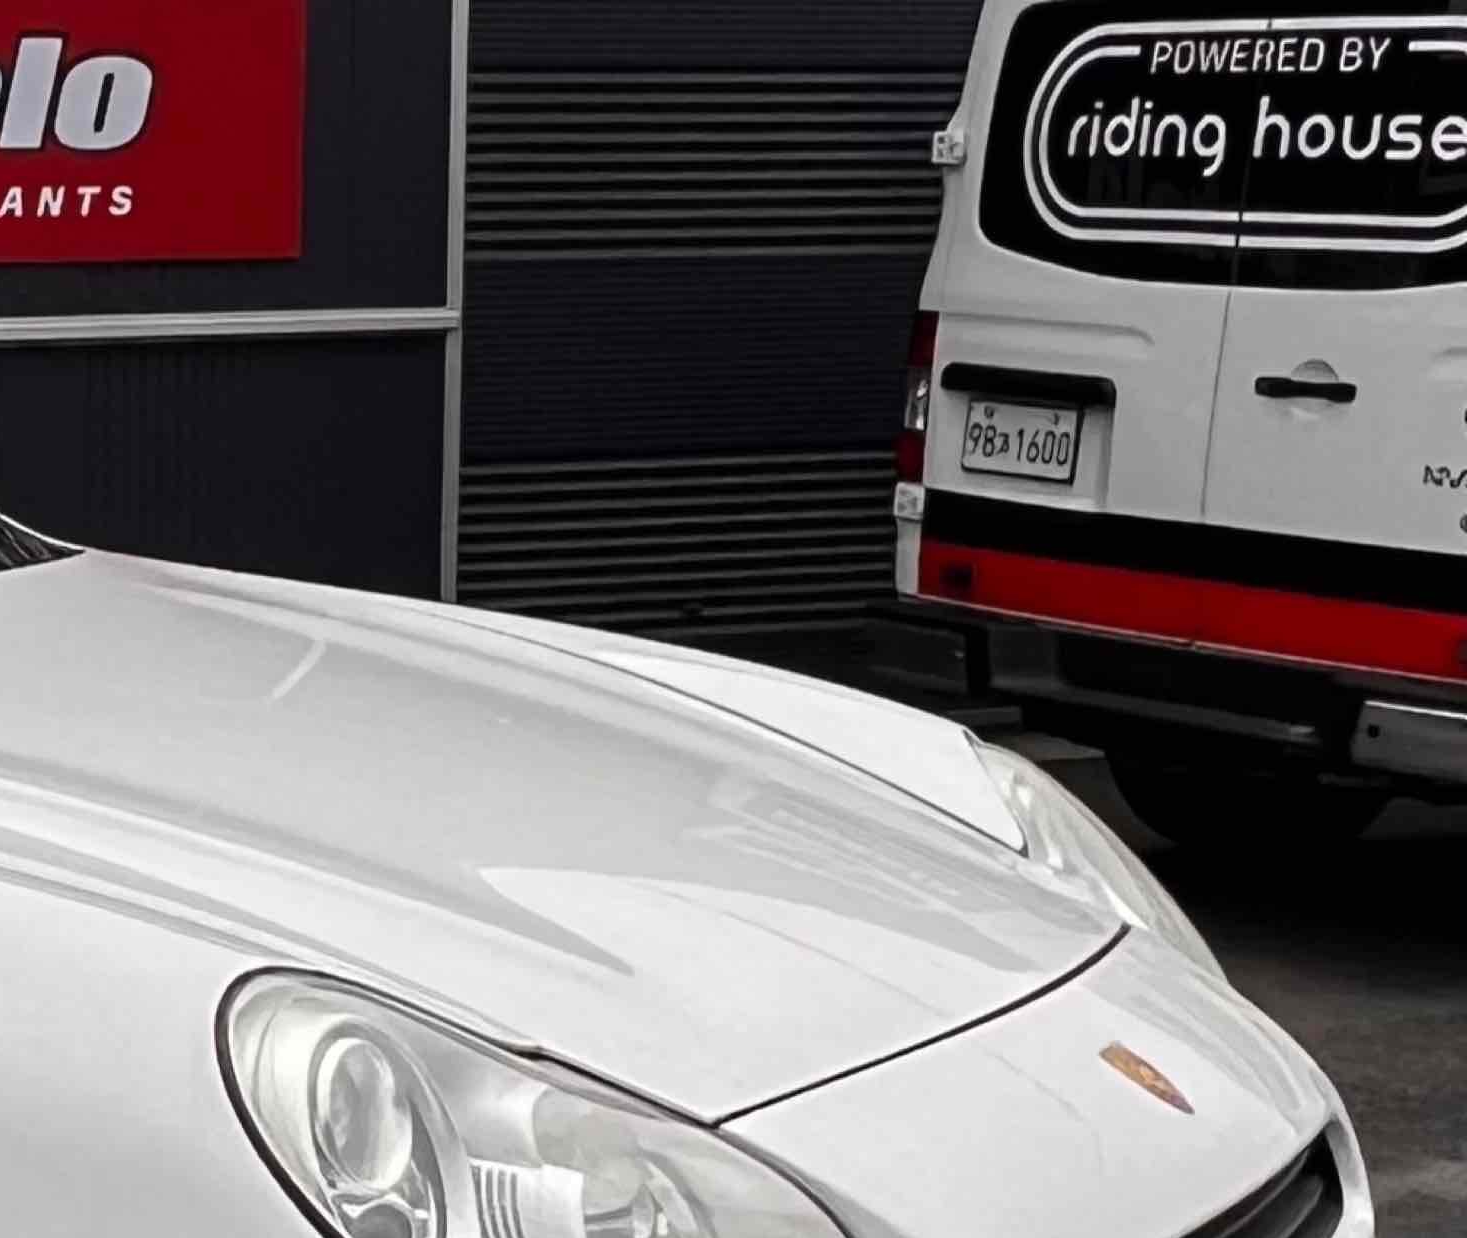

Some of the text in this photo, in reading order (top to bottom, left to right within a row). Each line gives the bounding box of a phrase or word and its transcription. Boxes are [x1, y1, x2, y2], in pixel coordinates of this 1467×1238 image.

[1150, 37, 1390, 75] POWERED BY
[1067, 96, 1467, 177] riding house
